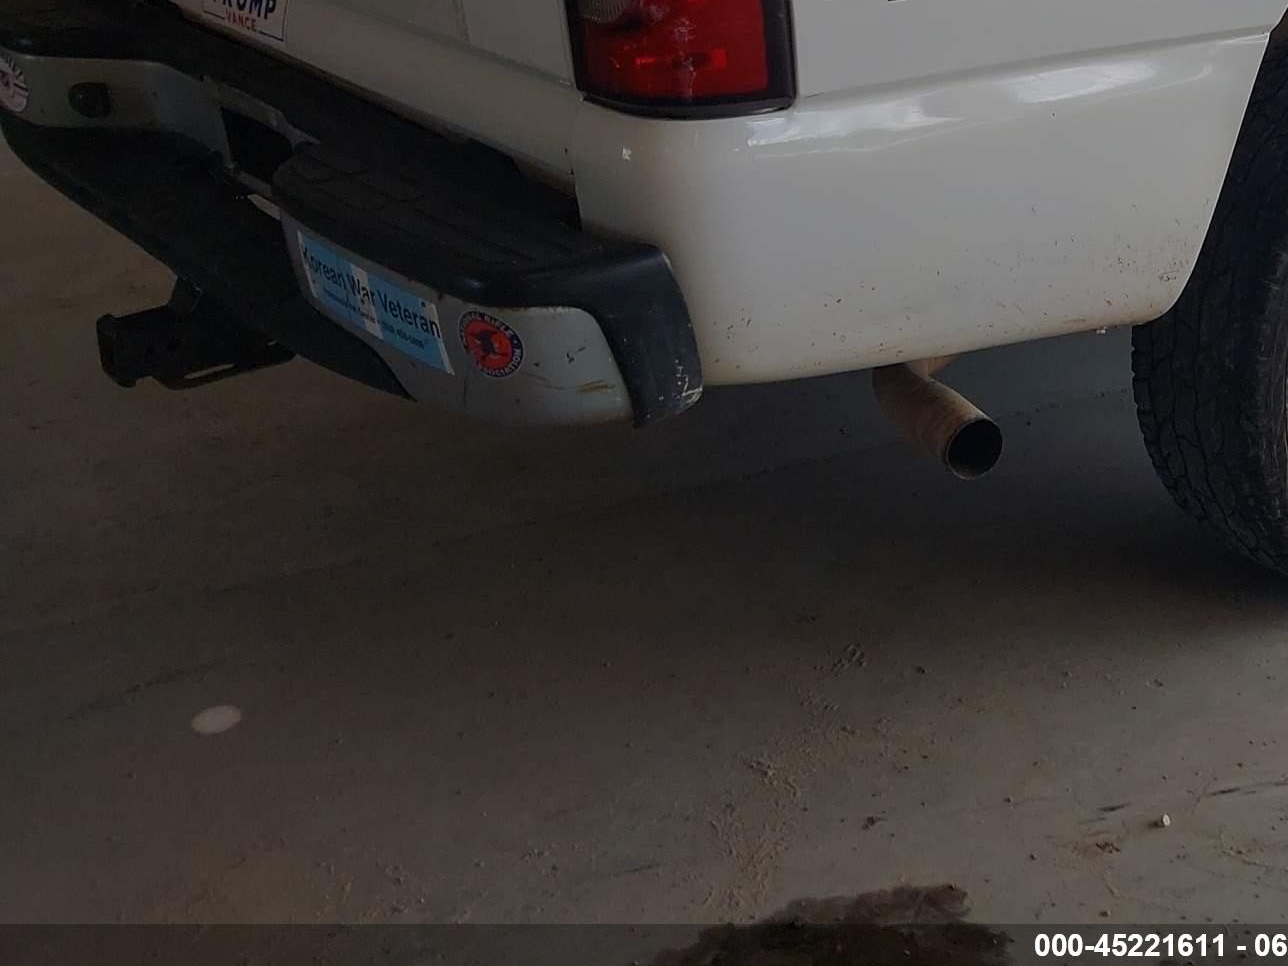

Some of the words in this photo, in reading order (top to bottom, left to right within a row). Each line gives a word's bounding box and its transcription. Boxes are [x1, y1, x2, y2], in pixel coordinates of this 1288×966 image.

[224, 9, 257, 33] VANCE
[347, 274, 376, 306] War
[376, 288, 441, 338] Veteran
